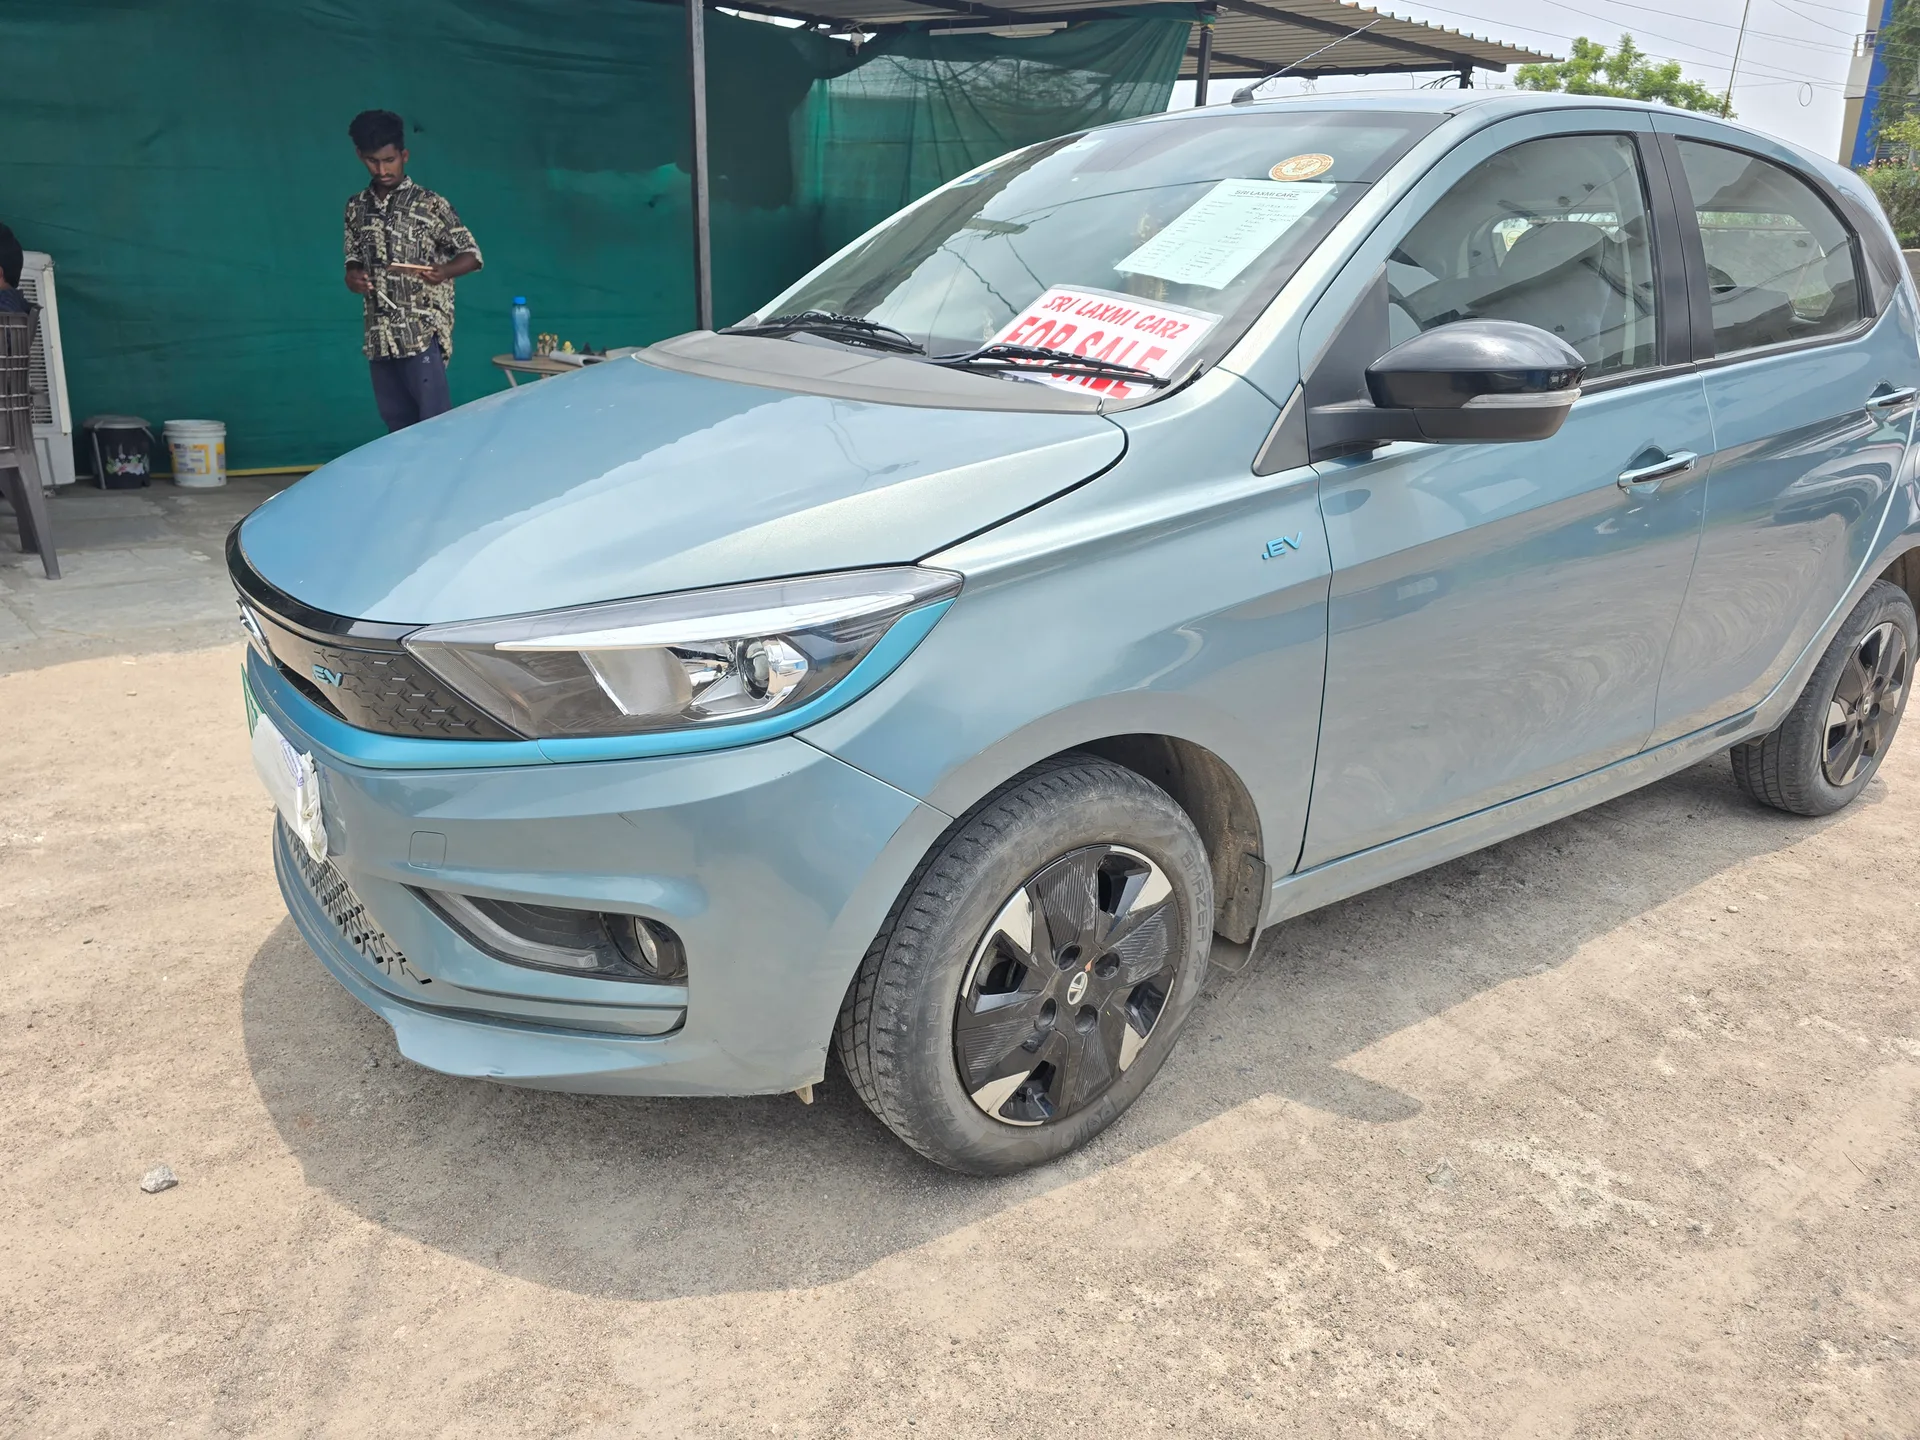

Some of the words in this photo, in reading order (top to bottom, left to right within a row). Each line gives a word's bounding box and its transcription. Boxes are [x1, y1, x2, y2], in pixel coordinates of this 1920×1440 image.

[1042, 295, 1080, 312] SRI
[1075, 300, 1140, 326] LAXMI
[1134, 315, 1190, 340] CARZ
[1000, 316, 1078, 366] FOR
[1051, 331, 1168, 399] SALE
[312, 664, 343, 687] EV
